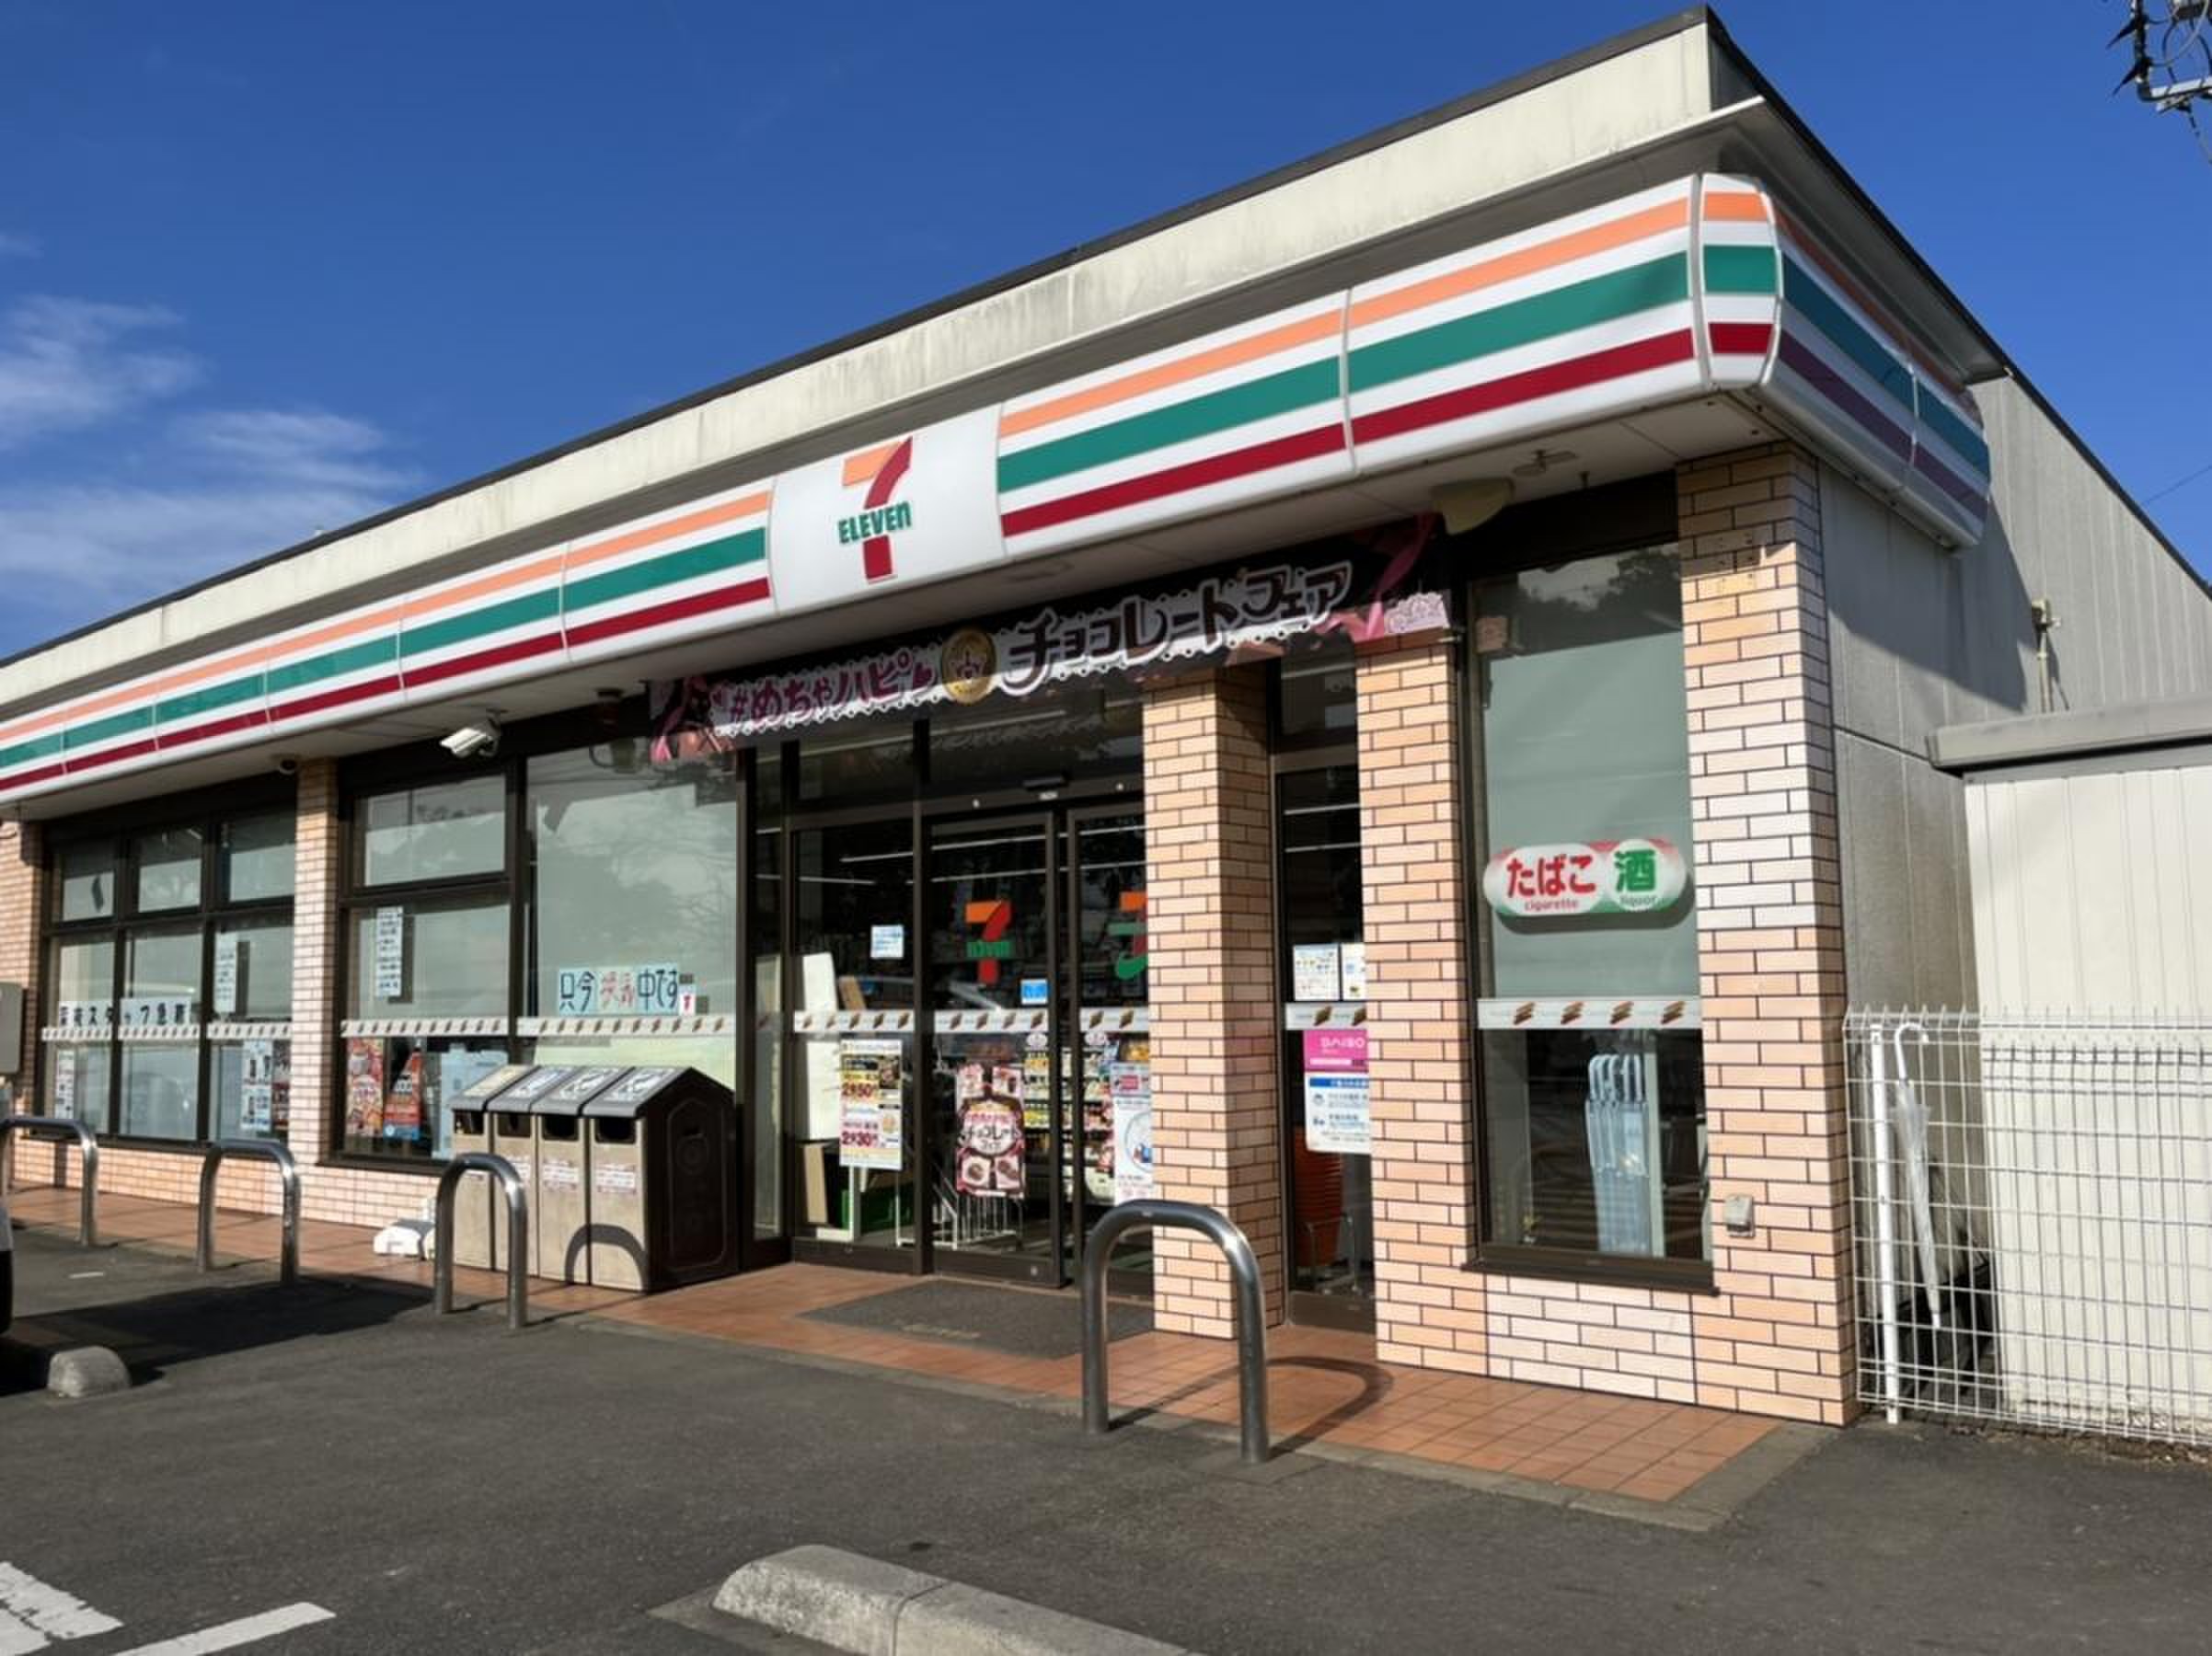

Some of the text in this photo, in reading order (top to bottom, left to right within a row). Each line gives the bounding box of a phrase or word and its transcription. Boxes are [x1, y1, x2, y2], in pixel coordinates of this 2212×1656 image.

[842, 435, 913, 581] 7
[999, 562, 1351, 696] チョコレートフェア
[1505, 854, 1597, 899] たばこ
[1614, 848, 1656, 892] 酒
